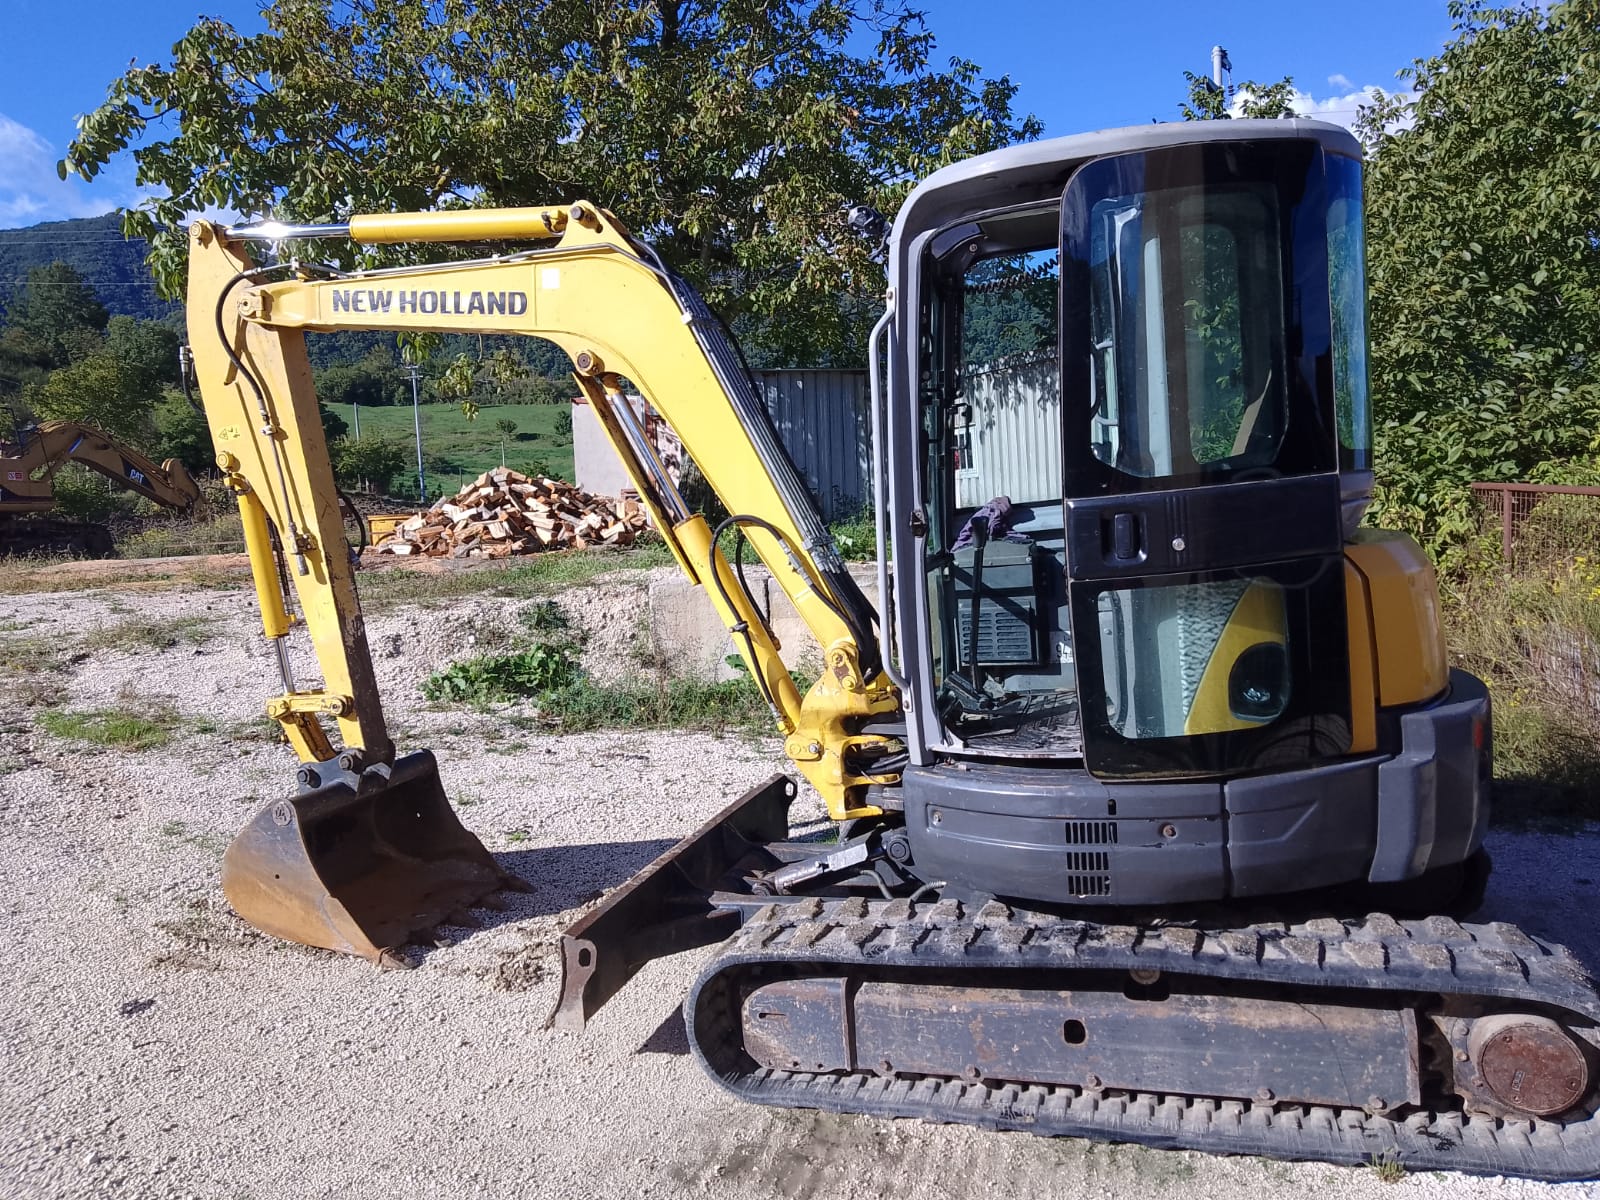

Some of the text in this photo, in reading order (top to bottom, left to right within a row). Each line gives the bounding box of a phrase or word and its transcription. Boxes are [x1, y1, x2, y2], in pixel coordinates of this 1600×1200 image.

[333, 290, 527, 315] NEW HOLLAND
[130, 469, 144, 484] CAT
